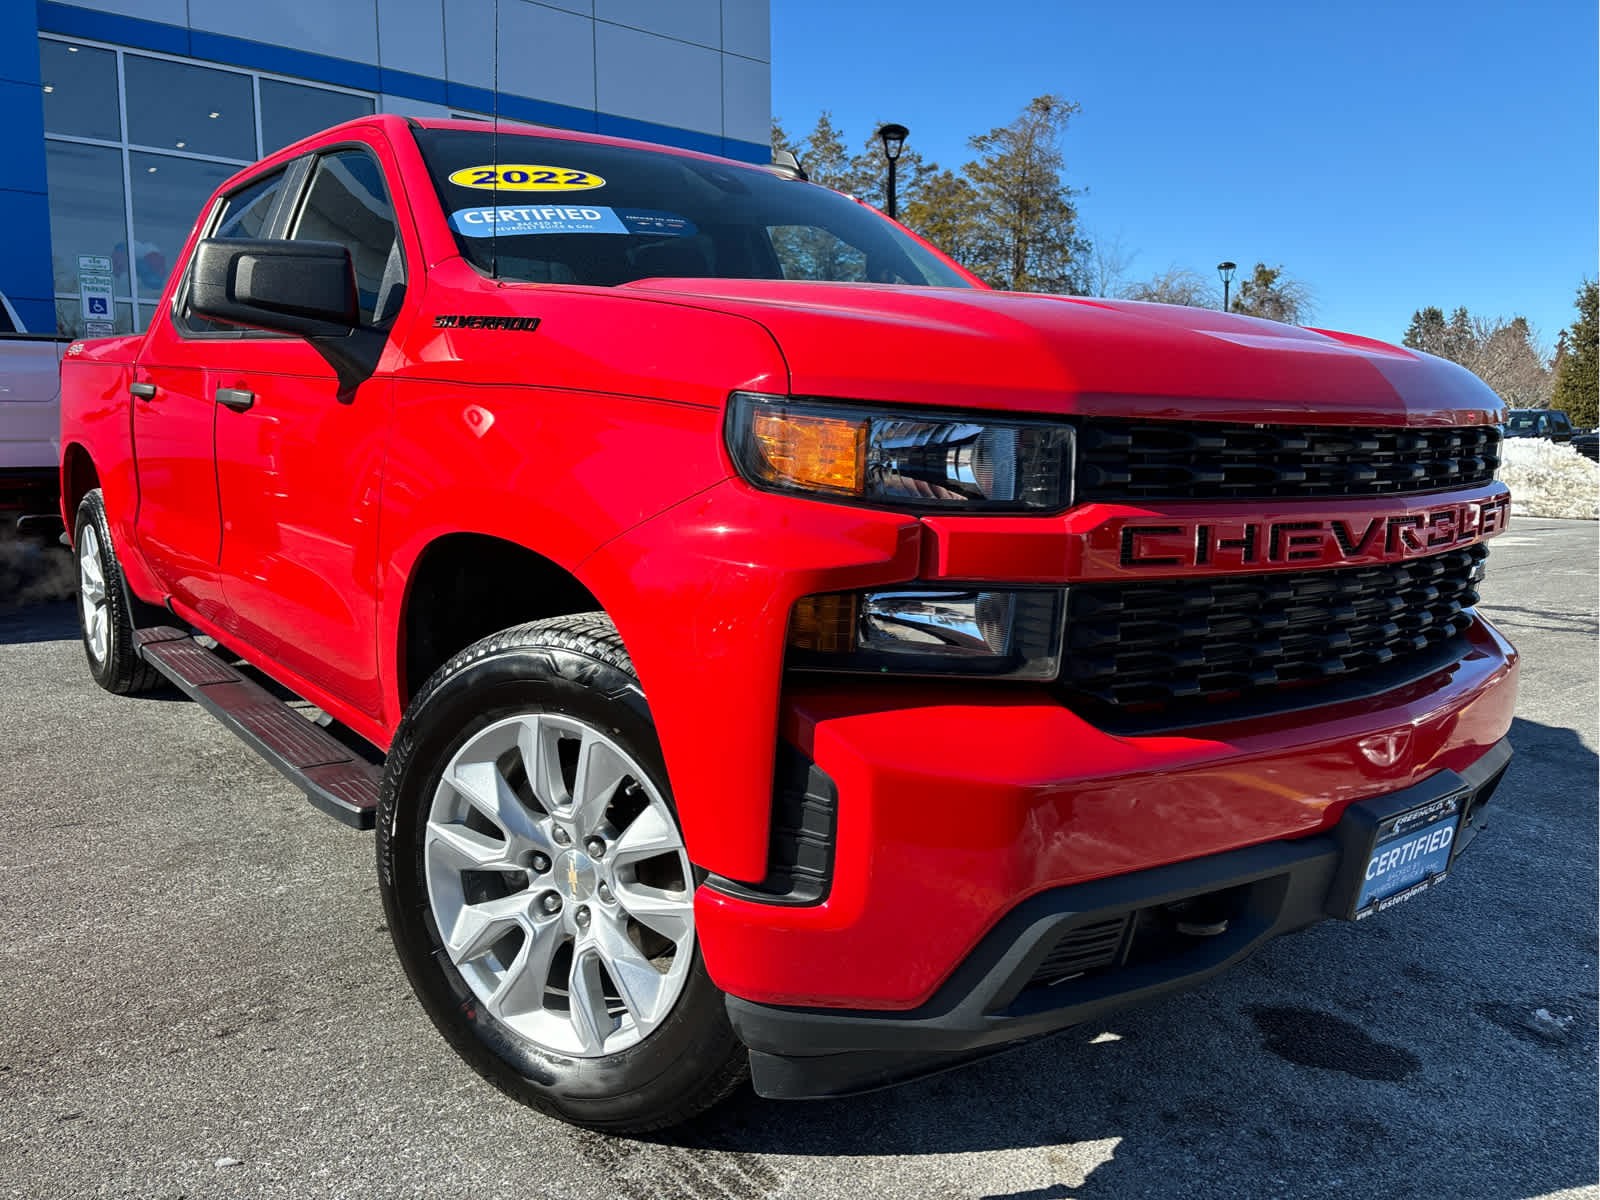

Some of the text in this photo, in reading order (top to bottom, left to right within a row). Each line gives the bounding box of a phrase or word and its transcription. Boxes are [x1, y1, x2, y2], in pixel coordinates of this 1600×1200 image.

[472, 169, 590, 186] 2022
[463, 208, 601, 224] CERTIFIED
[432, 315, 541, 332] SILVERADO
[1119, 497, 1512, 569] CHEVROLET
[1364, 825, 1454, 881] CERTIFIED
